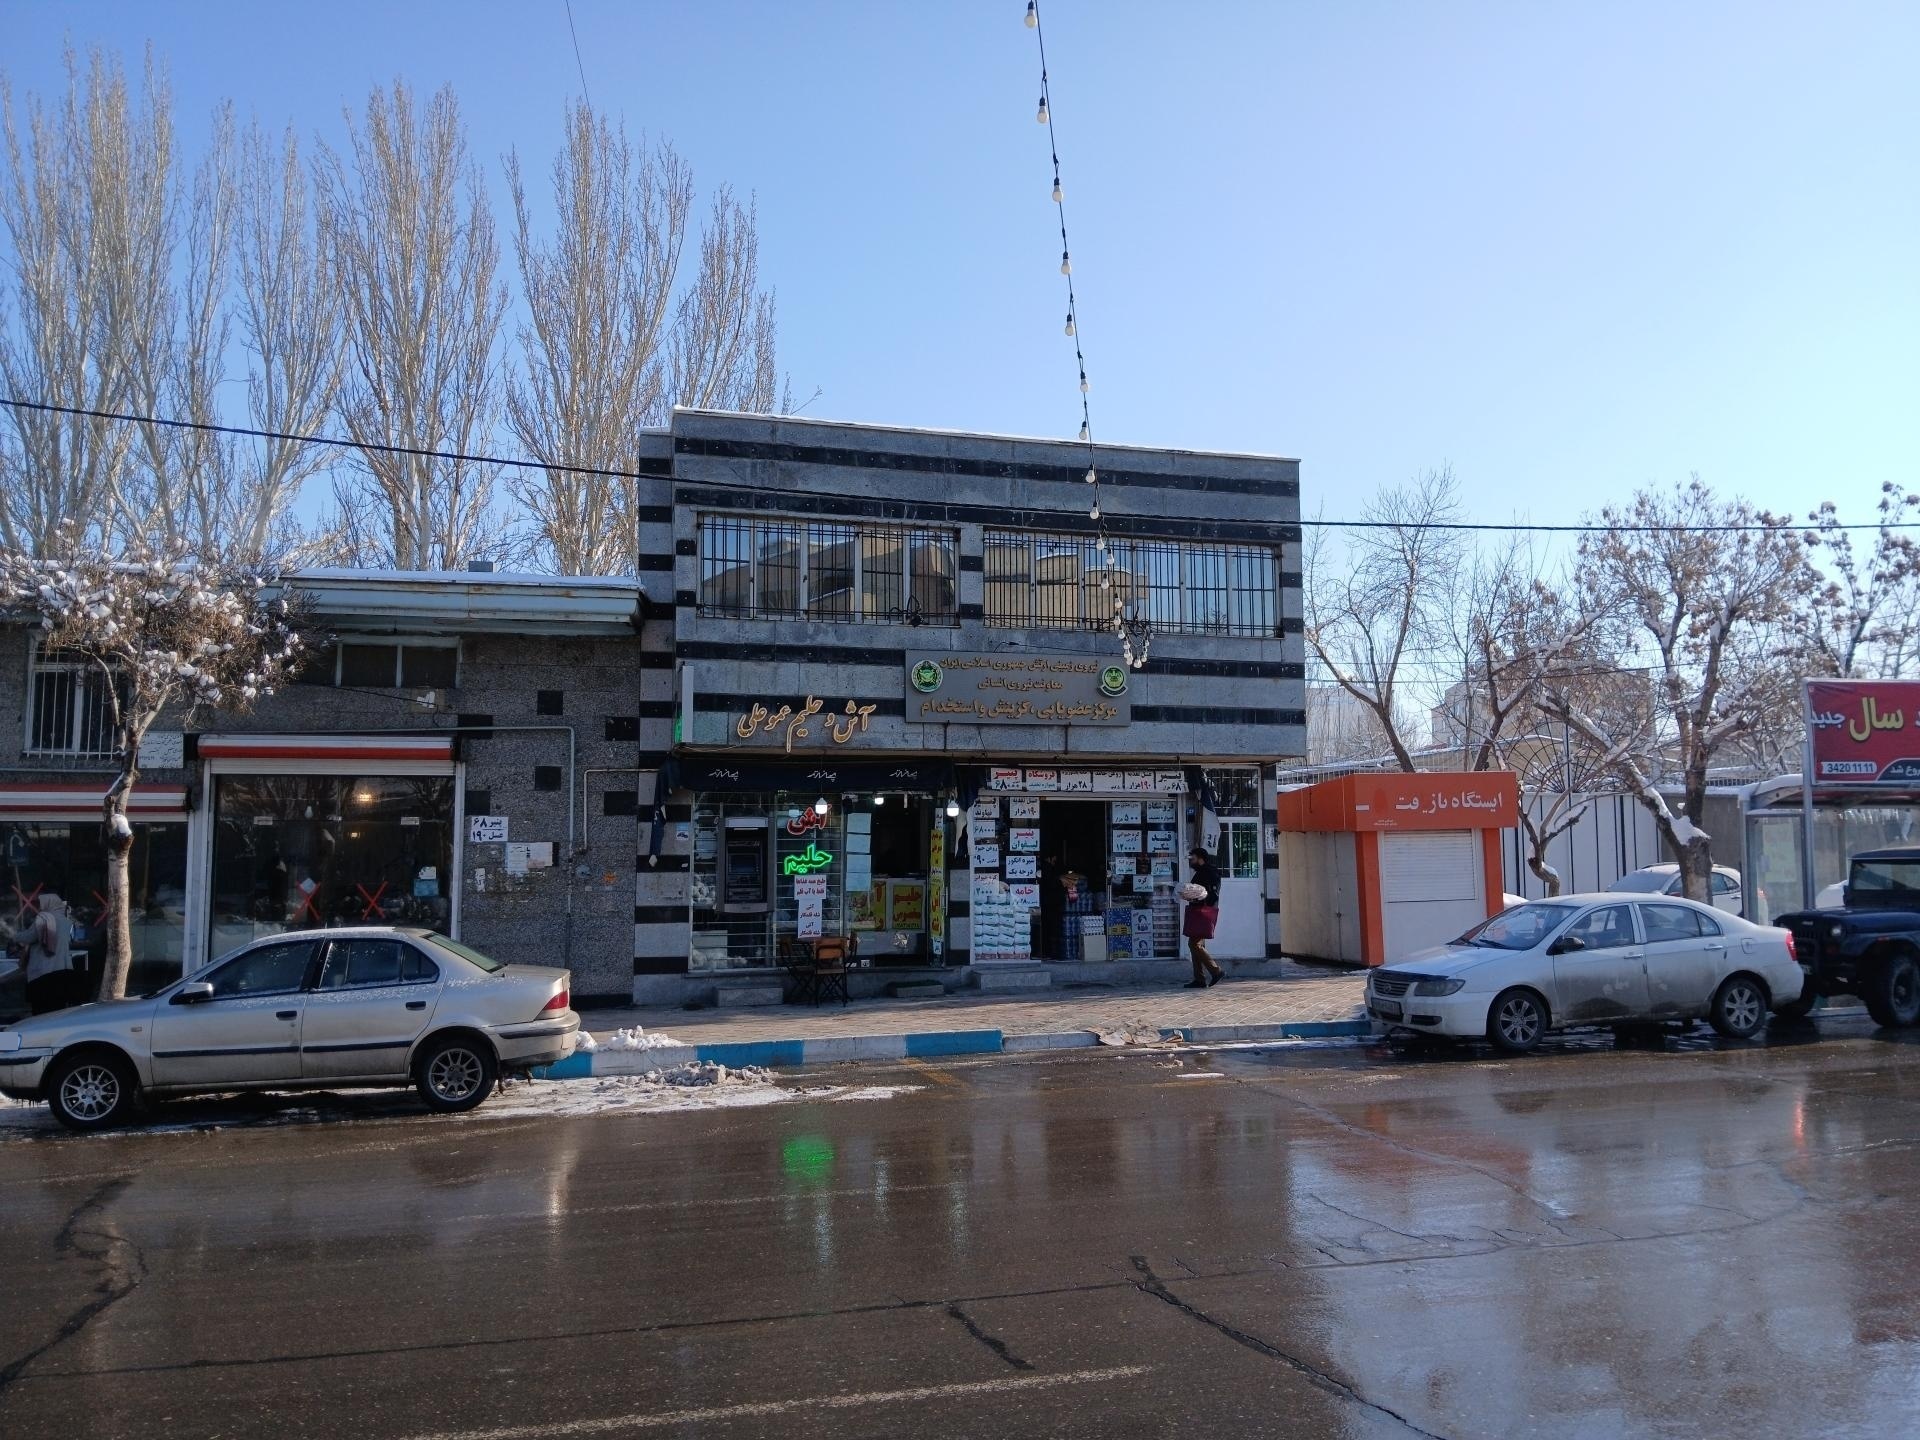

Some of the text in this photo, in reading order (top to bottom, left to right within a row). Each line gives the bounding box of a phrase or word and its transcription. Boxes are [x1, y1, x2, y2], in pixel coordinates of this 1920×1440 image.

[939, 656, 1099, 673] نیروی زمینی ارتش جمهوری اسلامی ایران
[977, 677, 1064, 692] معاونت نیروی انسانی
[920, 697, 977, 718] استخدام
[977, 705, 986, 718] و
[987, 699, 1030, 720] گزینش
[1091, 702, 1118, 720] مرکز
[737, 695, 876, 753] آش و حلیم عمو علی
[1811, 709, 1846, 728] جدید
[1849, 697, 1904, 741] سال
[993, 770, 1018, 780] پنیر
[1028, 770, 1055, 780] فروشگاه
[1157, 771, 1183, 783] پنیر
[1065, 781, 1078, 791] هزار
[1140, 780, 1151, 790] ۱۹۰
[1148, 801, 1174, 812] فروشگاه
[1451, 791, 1503, 813] ایستگاه
[489, 818, 502, 828] پنیر
[472, 830, 504, 841] عسل ۱۹۰
[1015, 829, 1034, 839] پنیر
[1151, 831, 1172, 842] قند
[1152, 842, 1170, 853] شکر
[784, 843, 833, 876] حلیم
[1007, 857, 1035, 865] شیره انگور
[1015, 886, 1034, 895] خامه
